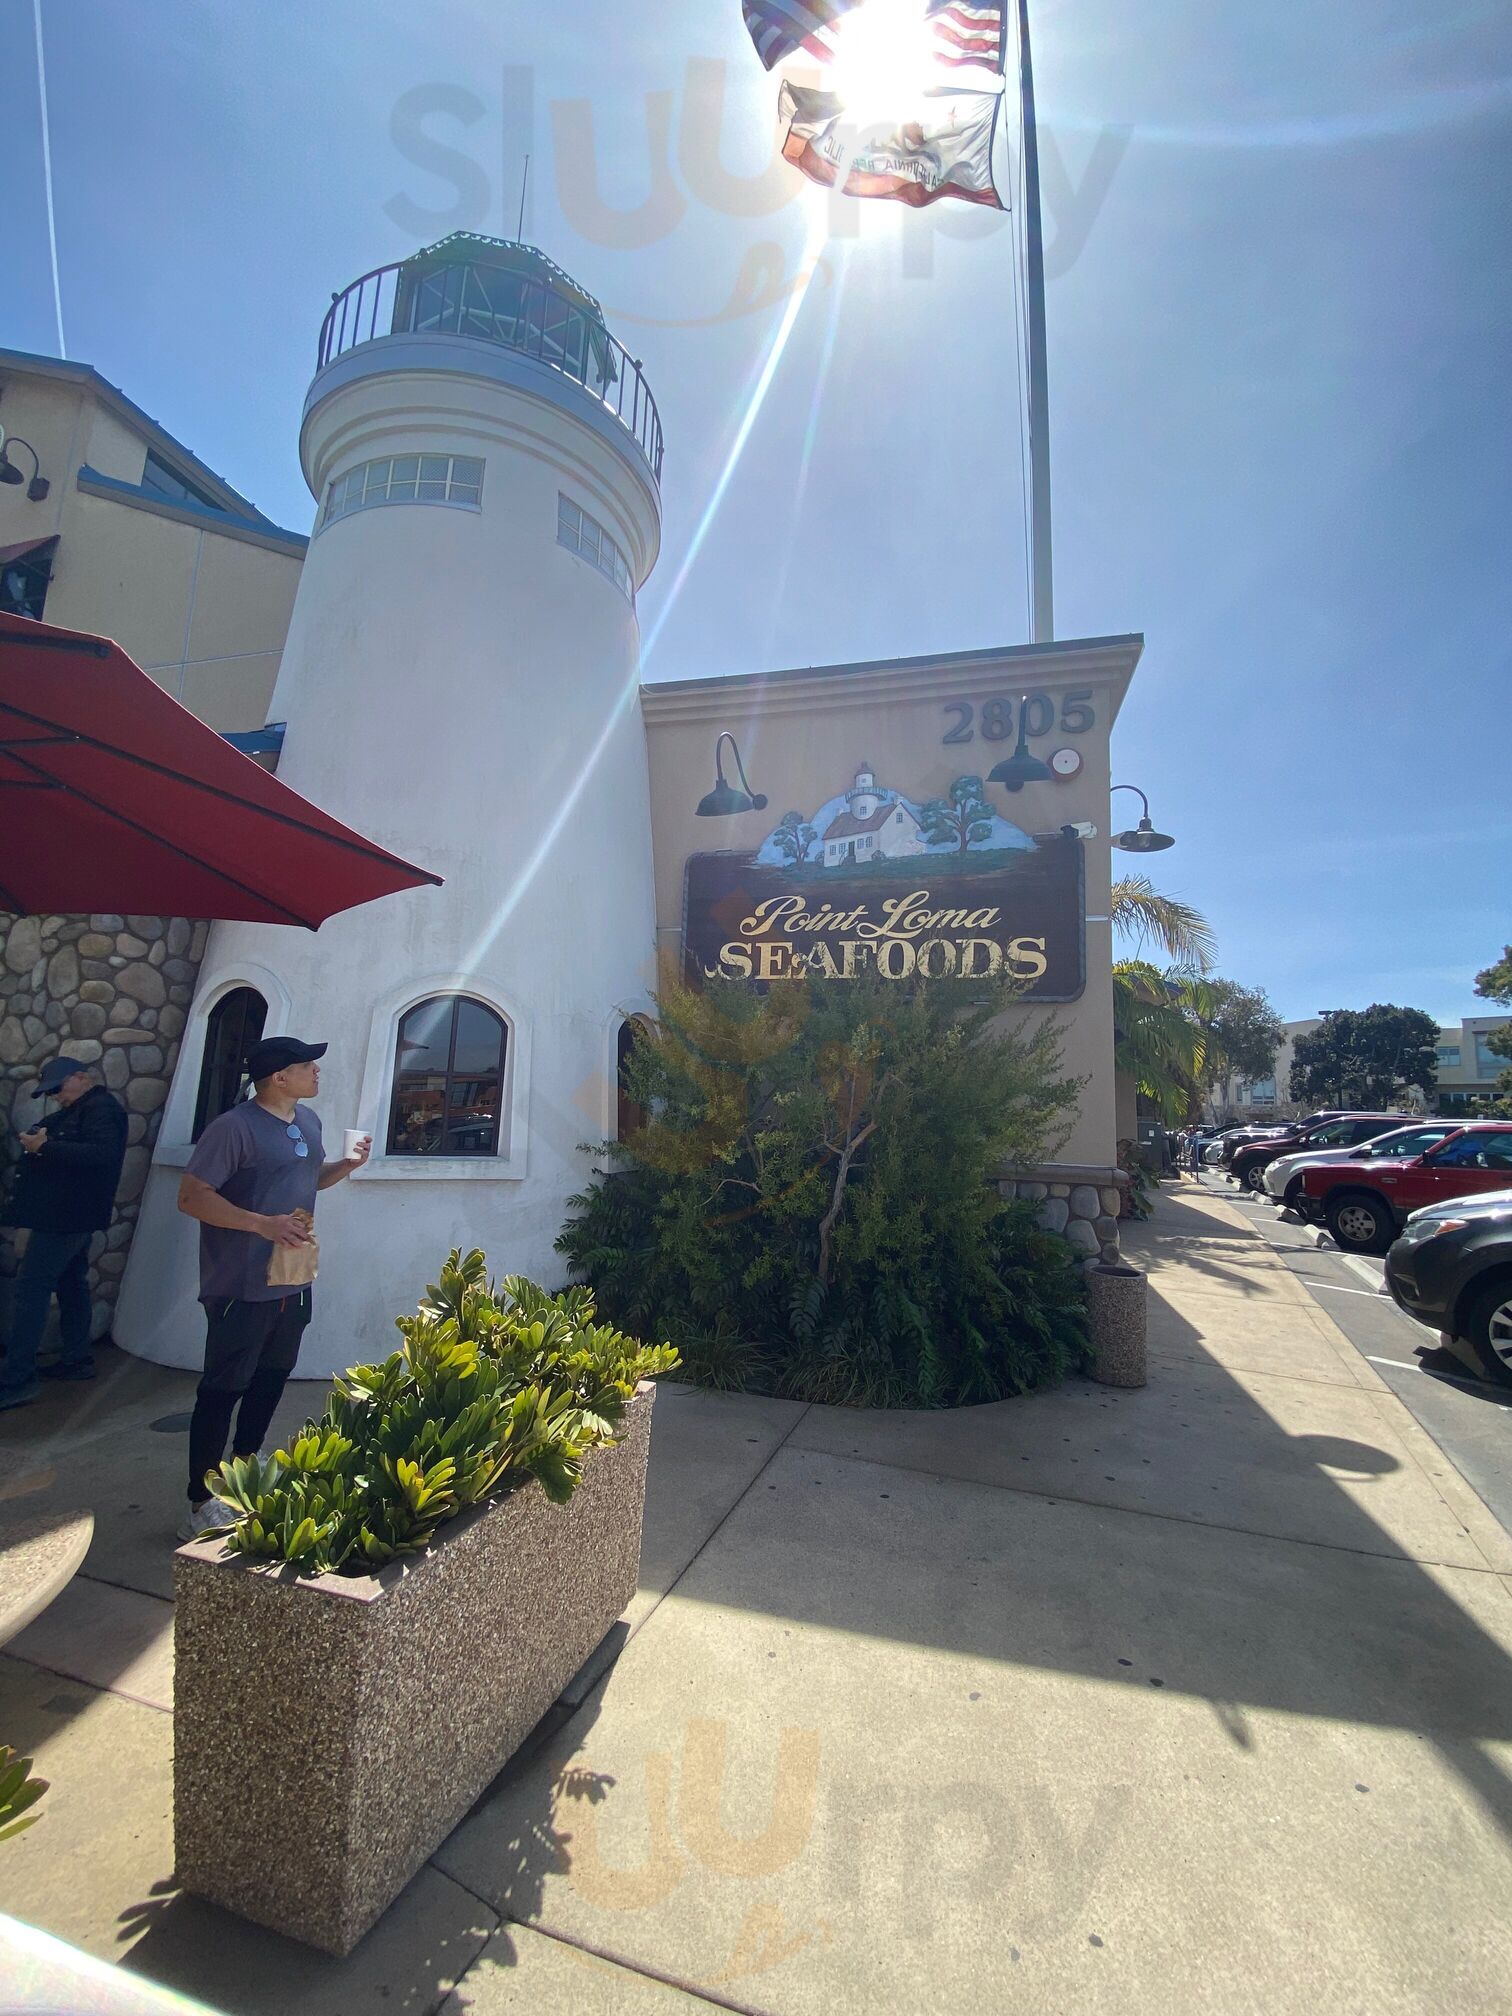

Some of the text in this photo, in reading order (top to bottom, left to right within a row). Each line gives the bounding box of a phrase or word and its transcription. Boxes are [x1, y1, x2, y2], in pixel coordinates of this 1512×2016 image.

[942, 690, 1095, 744] 2805
[739, 890, 1002, 940] Point Loma
[704, 937, 1048, 981] SEAFOODS
